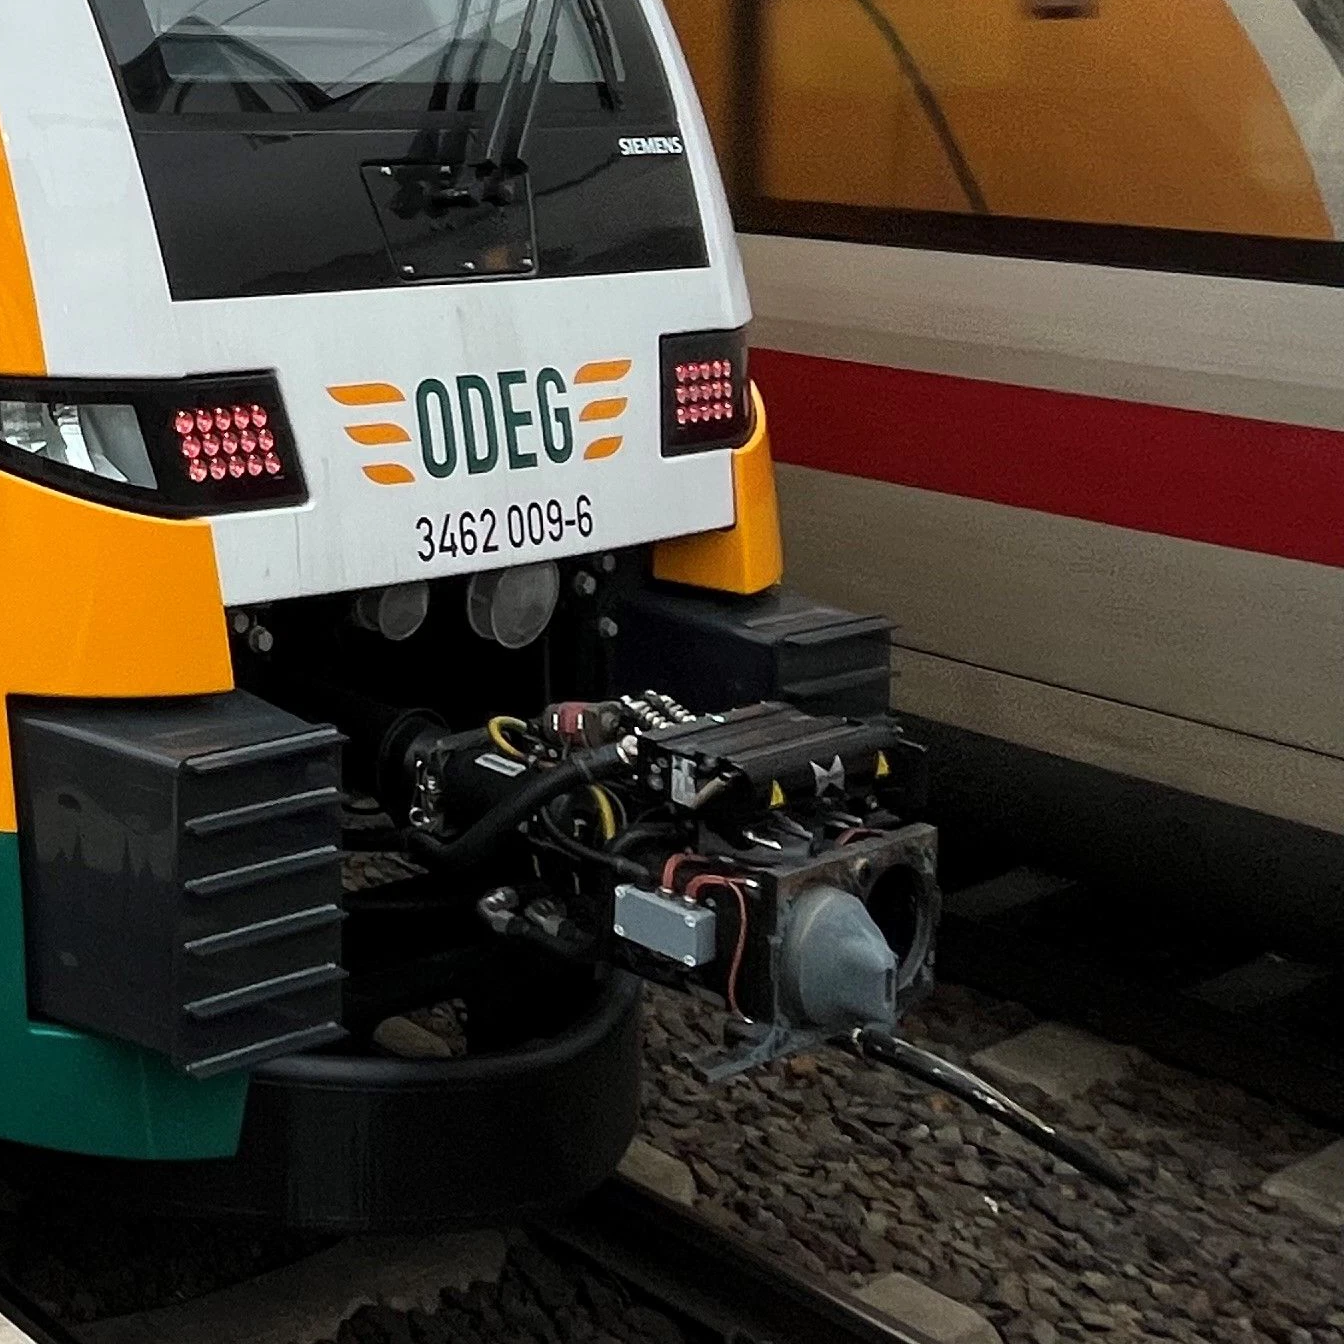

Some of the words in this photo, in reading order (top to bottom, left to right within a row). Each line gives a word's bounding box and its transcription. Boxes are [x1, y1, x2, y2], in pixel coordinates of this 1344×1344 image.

[618, 136, 684, 155] SIEMENS
[416, 367, 573, 479] ODEG
[416, 508, 500, 562] 3462
[507, 494, 594, 548] 009-6
